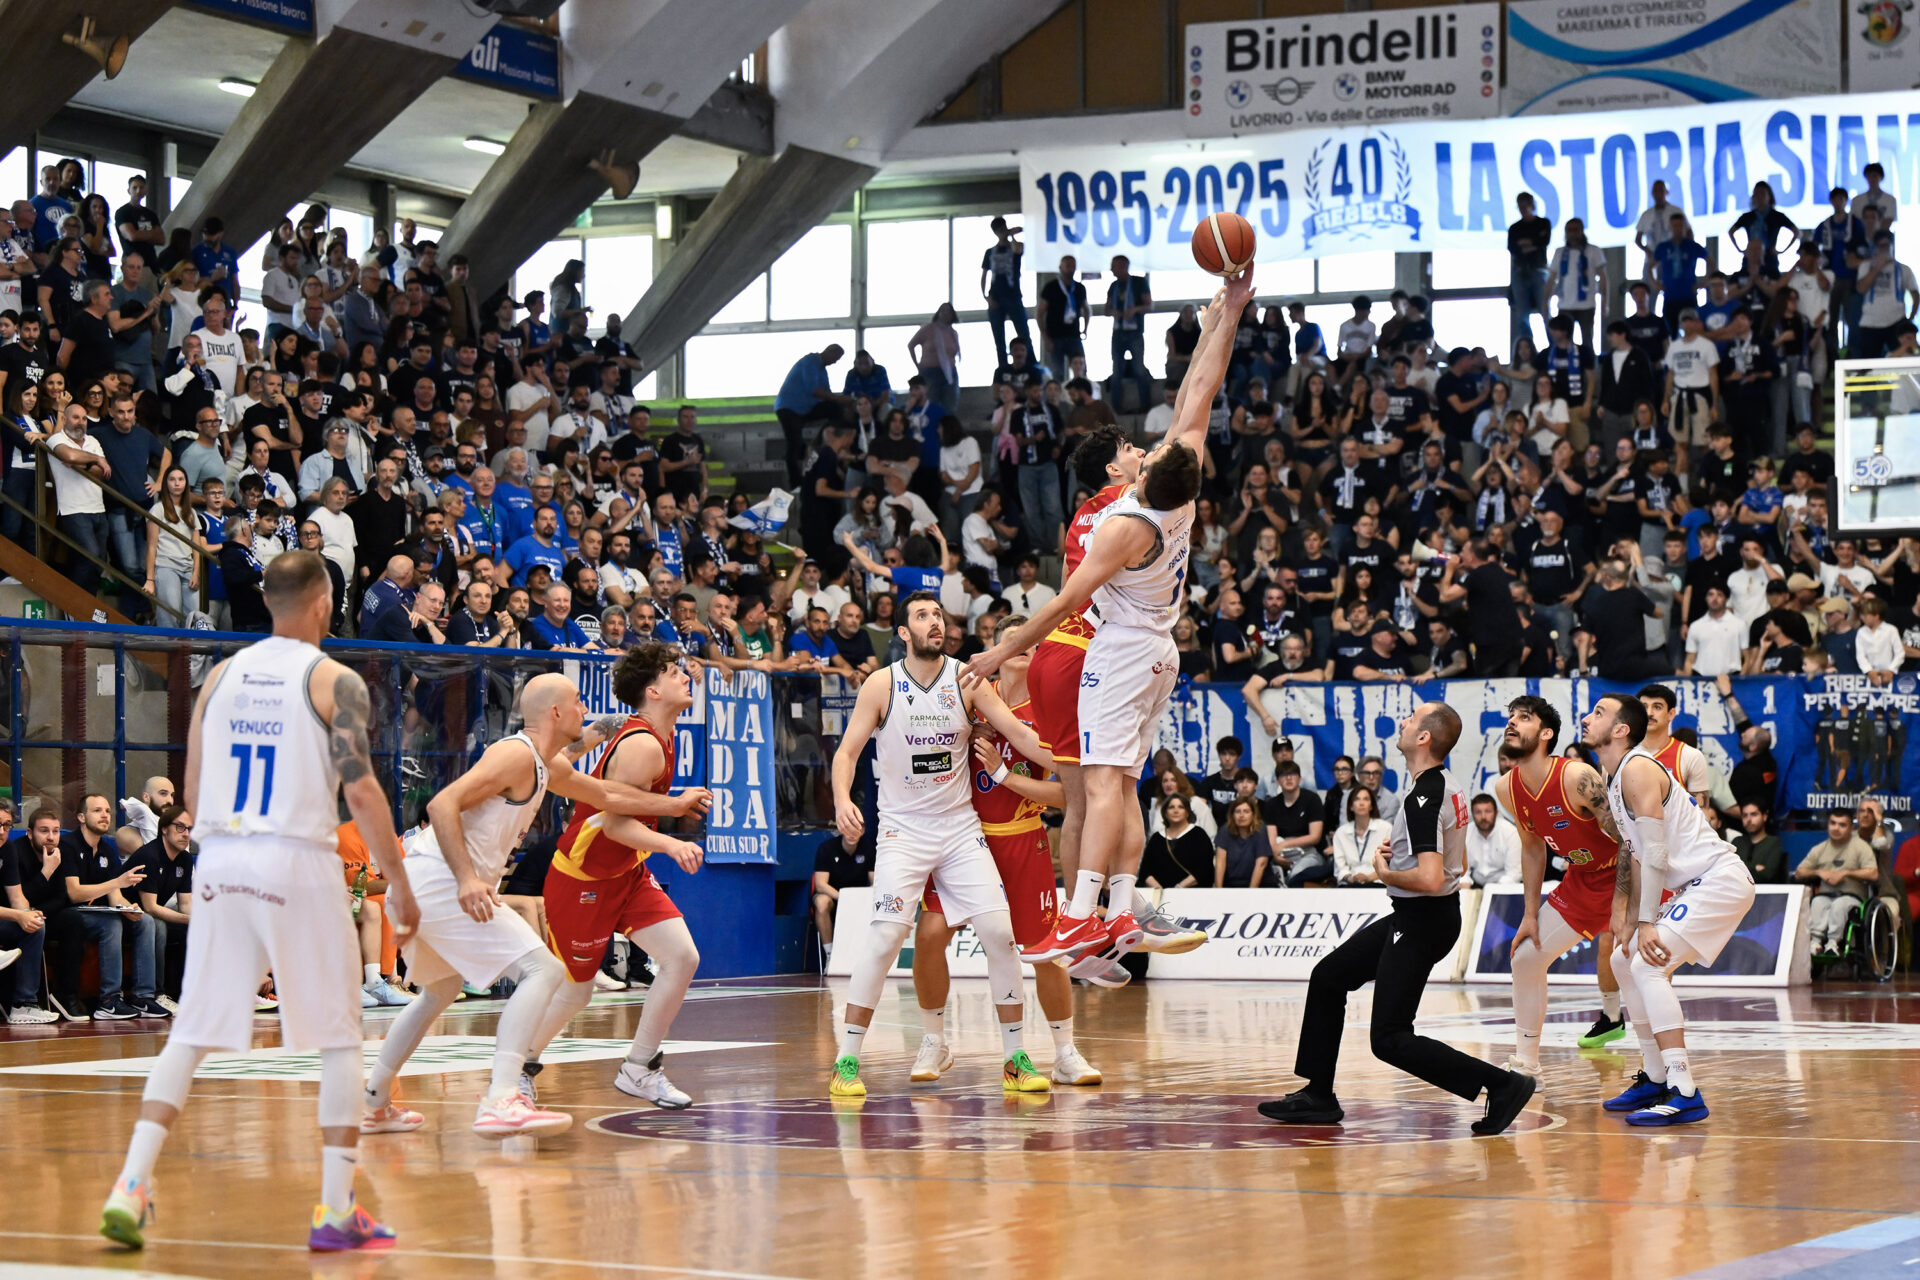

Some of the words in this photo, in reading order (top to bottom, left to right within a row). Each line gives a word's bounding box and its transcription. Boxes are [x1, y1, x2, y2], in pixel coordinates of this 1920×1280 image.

[1557, 19, 1631, 34] MAREMMA
[1633, 17, 1642, 28] E
[1645, 12, 1706, 27] TIRRENO
[1226, 14, 1457, 72] Birindelli
[1365, 70, 1406, 85] BMW
[1365, 83, 1456, 100] MOTORRAD
[1230, 114, 1294, 128] LIVORNO
[1305, 108, 1328, 124] Via
[1330, 105, 1363, 122] delle
[1430, 102, 1450, 117] 96
[1036, 170, 1152, 247] 1985
[1163, 158, 1290, 244] 2025
[1330, 137, 1384, 206] 40
[1435, 141, 1506, 231] LA
[1519, 119, 1752, 233] STORIA
[1315, 203, 1408, 233] REBELS
[709, 668, 767, 700] GRUPPO
[896, 681, 910, 693] 18
[230, 719, 284, 736] VENUCCI
[905, 733, 958, 747] VeroDol
[230, 743, 276, 816] 11
[707, 835, 737, 854] CURVA
[739, 836, 758, 854] SUD
[1039, 889, 1054, 912] 14
[1663, 903, 1689, 921] 10
[1237, 944, 1323, 958] CANTIERE
